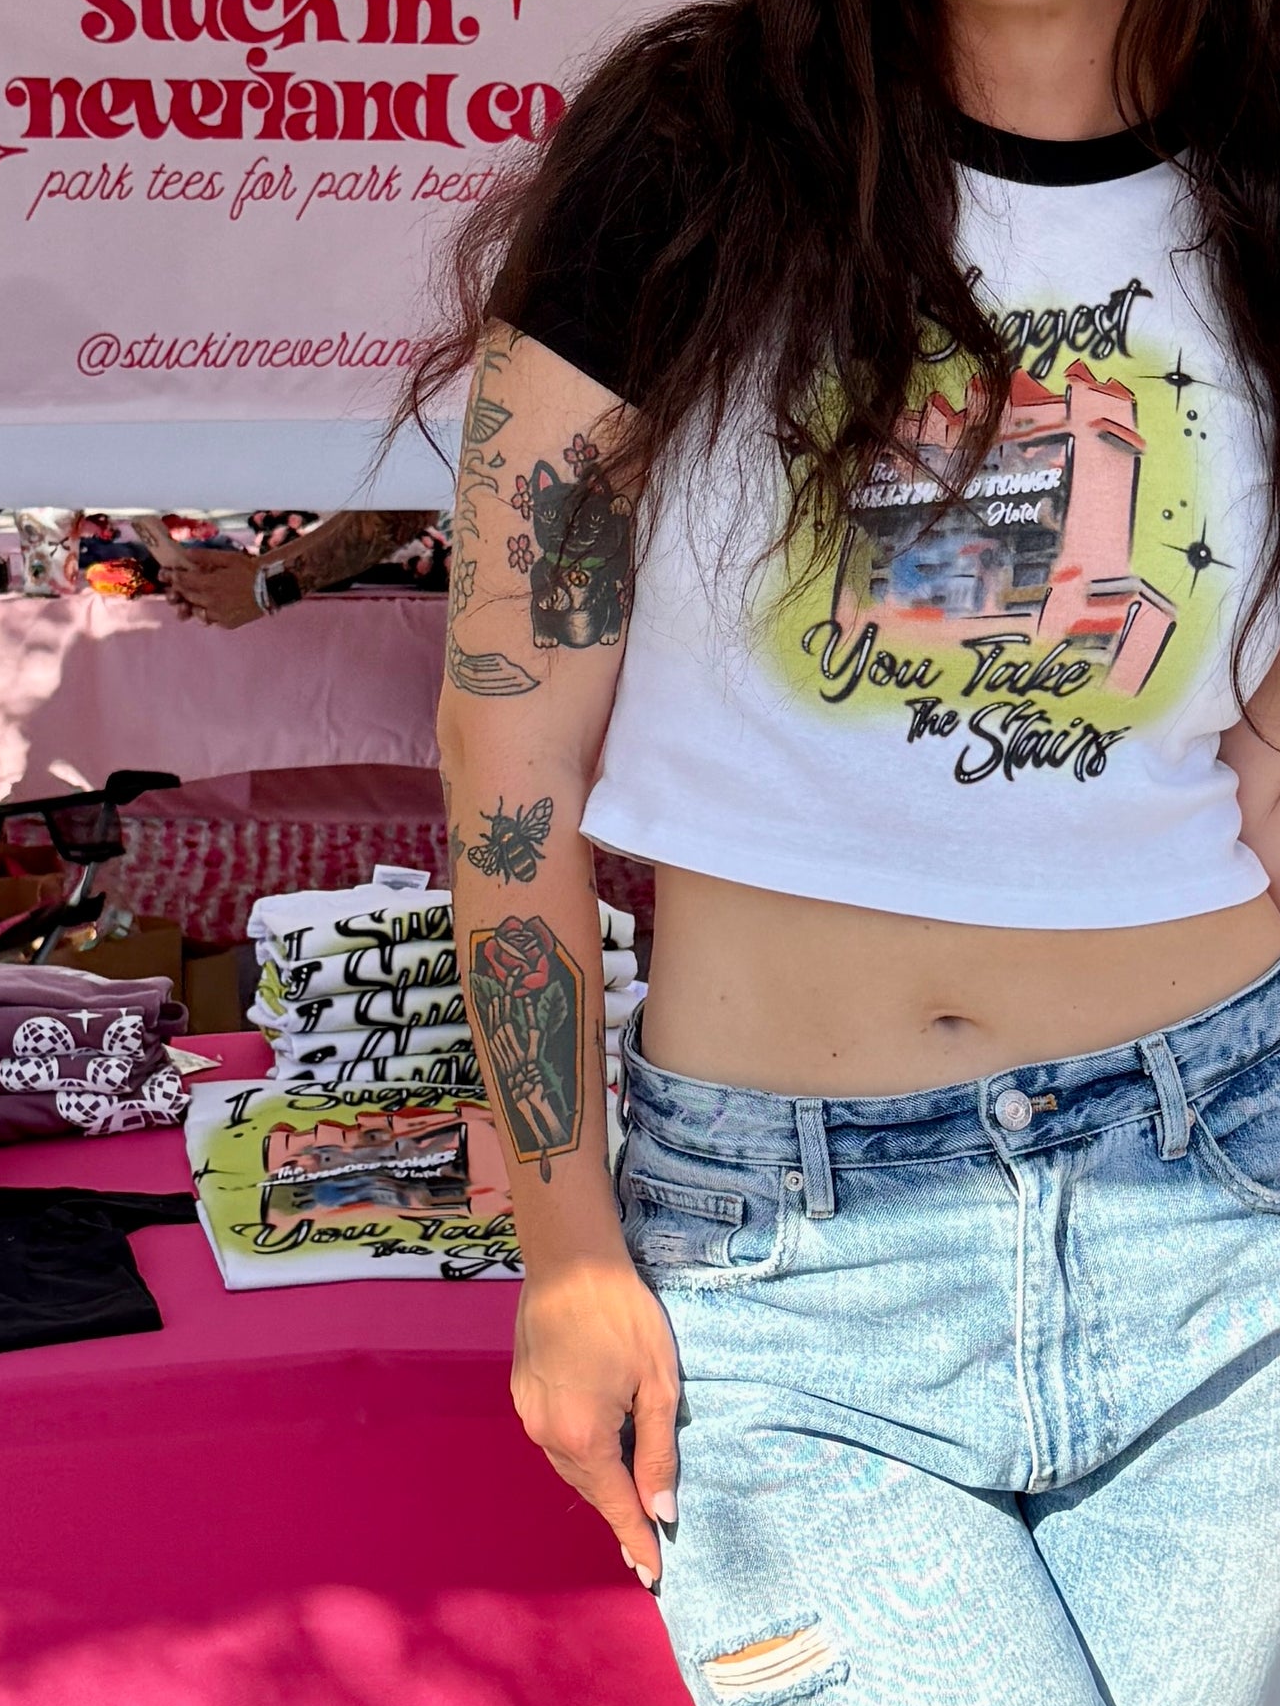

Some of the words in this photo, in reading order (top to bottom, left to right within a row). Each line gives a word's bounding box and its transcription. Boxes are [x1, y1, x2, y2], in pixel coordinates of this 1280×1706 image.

[5, 47, 466, 148] neverland
[27, 162, 133, 221] park
[147, 163, 224, 204] tees
[229, 156, 297, 221] for
[297, 162, 401, 221] park
[77, 331, 426, 377] @stuckinneverlan
[984, 469, 1064, 498] TOWER
[987, 501, 1041, 527] Hotel
[802, 620, 944, 703] You
[960, 632, 1093, 698] Take
[905, 696, 961, 743] The
[954, 699, 1132, 784] Stairs
[225, 1088, 264, 1130] I
[231, 1219, 392, 1254] You
[360, 1238, 436, 1259] The
